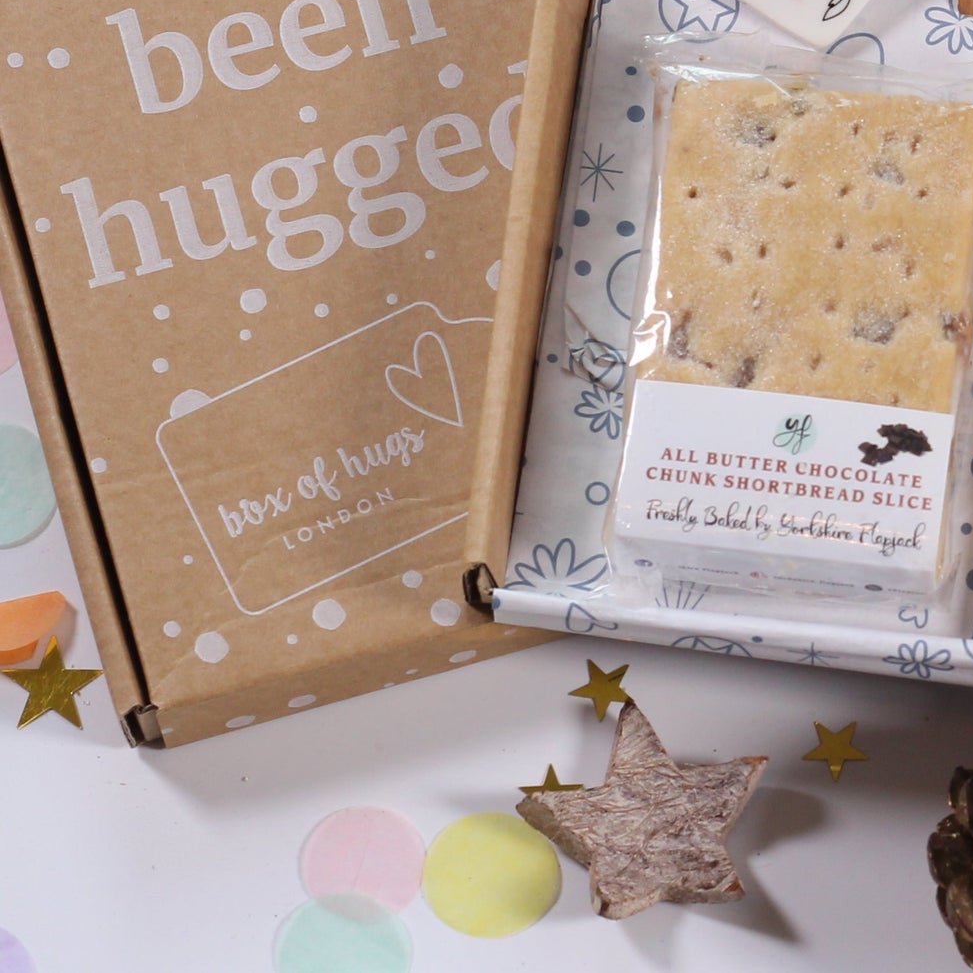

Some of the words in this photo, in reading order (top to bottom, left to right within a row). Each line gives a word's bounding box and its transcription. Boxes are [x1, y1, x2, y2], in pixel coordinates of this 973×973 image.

[218, 487, 292, 538] box
[297, 457, 340, 501] of
[337, 427, 425, 477] hugs
[646, 467, 716, 487] CHUNK
[724, 475, 865, 503] SHORTBREAD
[873, 491, 933, 511] SLICE
[660, 447, 699, 463] ALL
[706, 452, 787, 473] BUTTER
[795, 462, 922, 489] CHOCOLATE
[283, 487, 395, 550] LONDON
[646, 496, 698, 532] Freshly
[704, 502, 751, 530] Baked
[755, 505, 772, 539] by
[777, 512, 853, 542] Yorkshire
[859, 523, 926, 556] Flapjack
